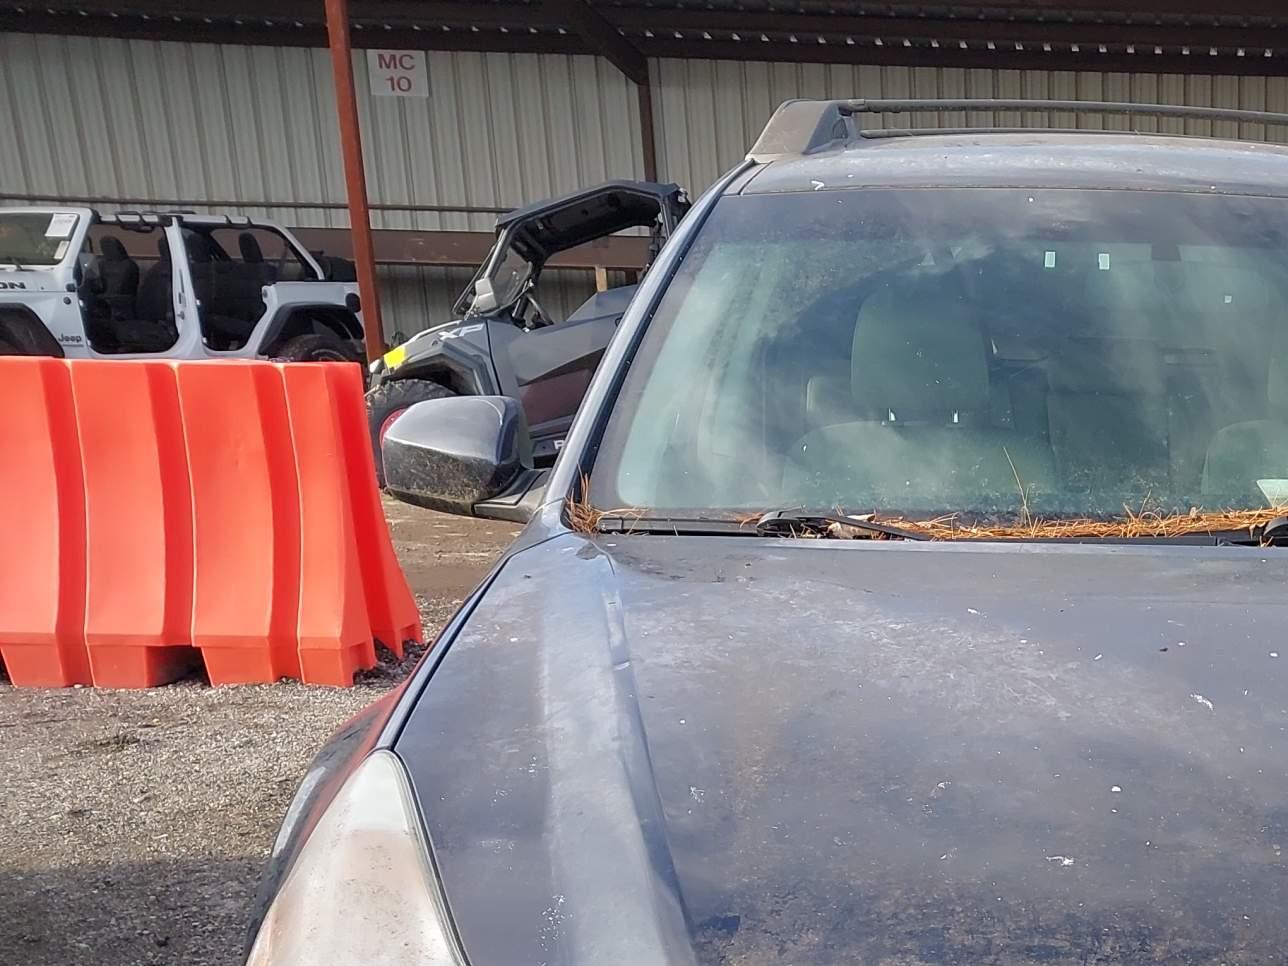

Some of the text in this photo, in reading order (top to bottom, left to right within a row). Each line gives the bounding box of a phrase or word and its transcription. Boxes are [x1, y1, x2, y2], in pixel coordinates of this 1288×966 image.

[377, 54, 416, 70] MC
[385, 76, 412, 92] 10
[58, 333, 82, 343] Jeep
[438, 323, 485, 340] XP
